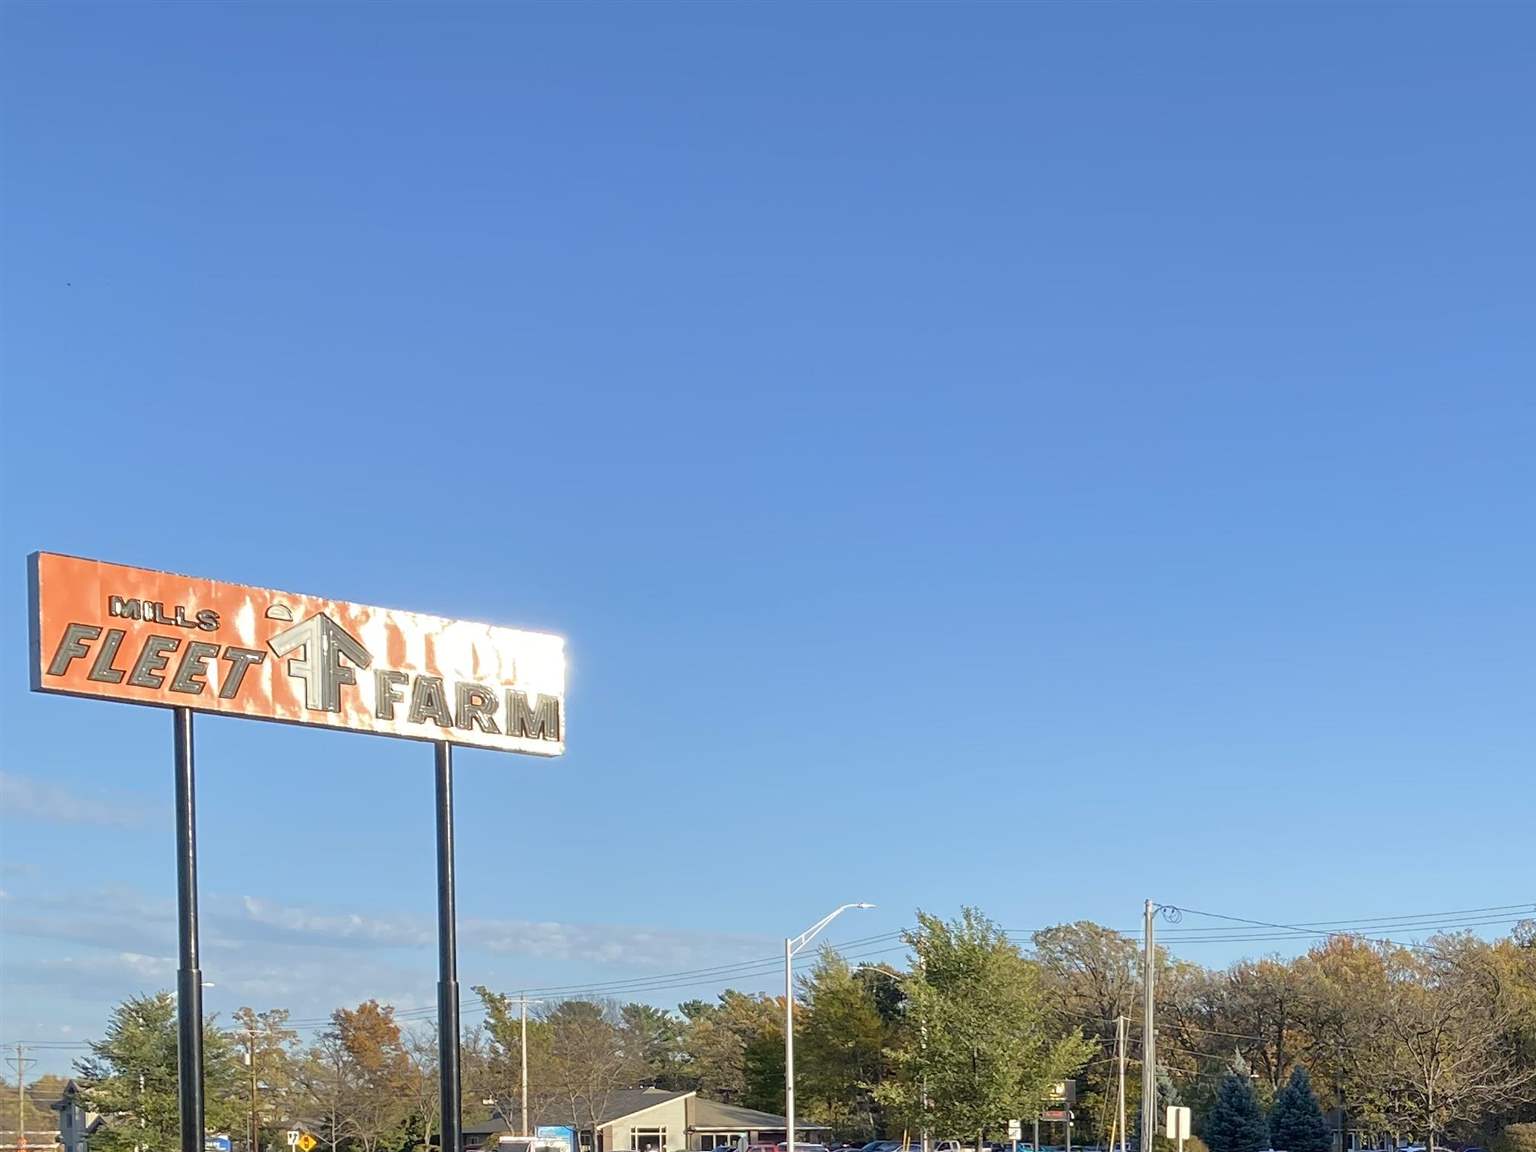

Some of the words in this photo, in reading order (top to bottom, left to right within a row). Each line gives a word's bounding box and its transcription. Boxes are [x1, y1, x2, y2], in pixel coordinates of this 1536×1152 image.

[109, 596, 220, 632] MILLS
[47, 622, 267, 699] FLEET
[373, 668, 560, 742] FARM
